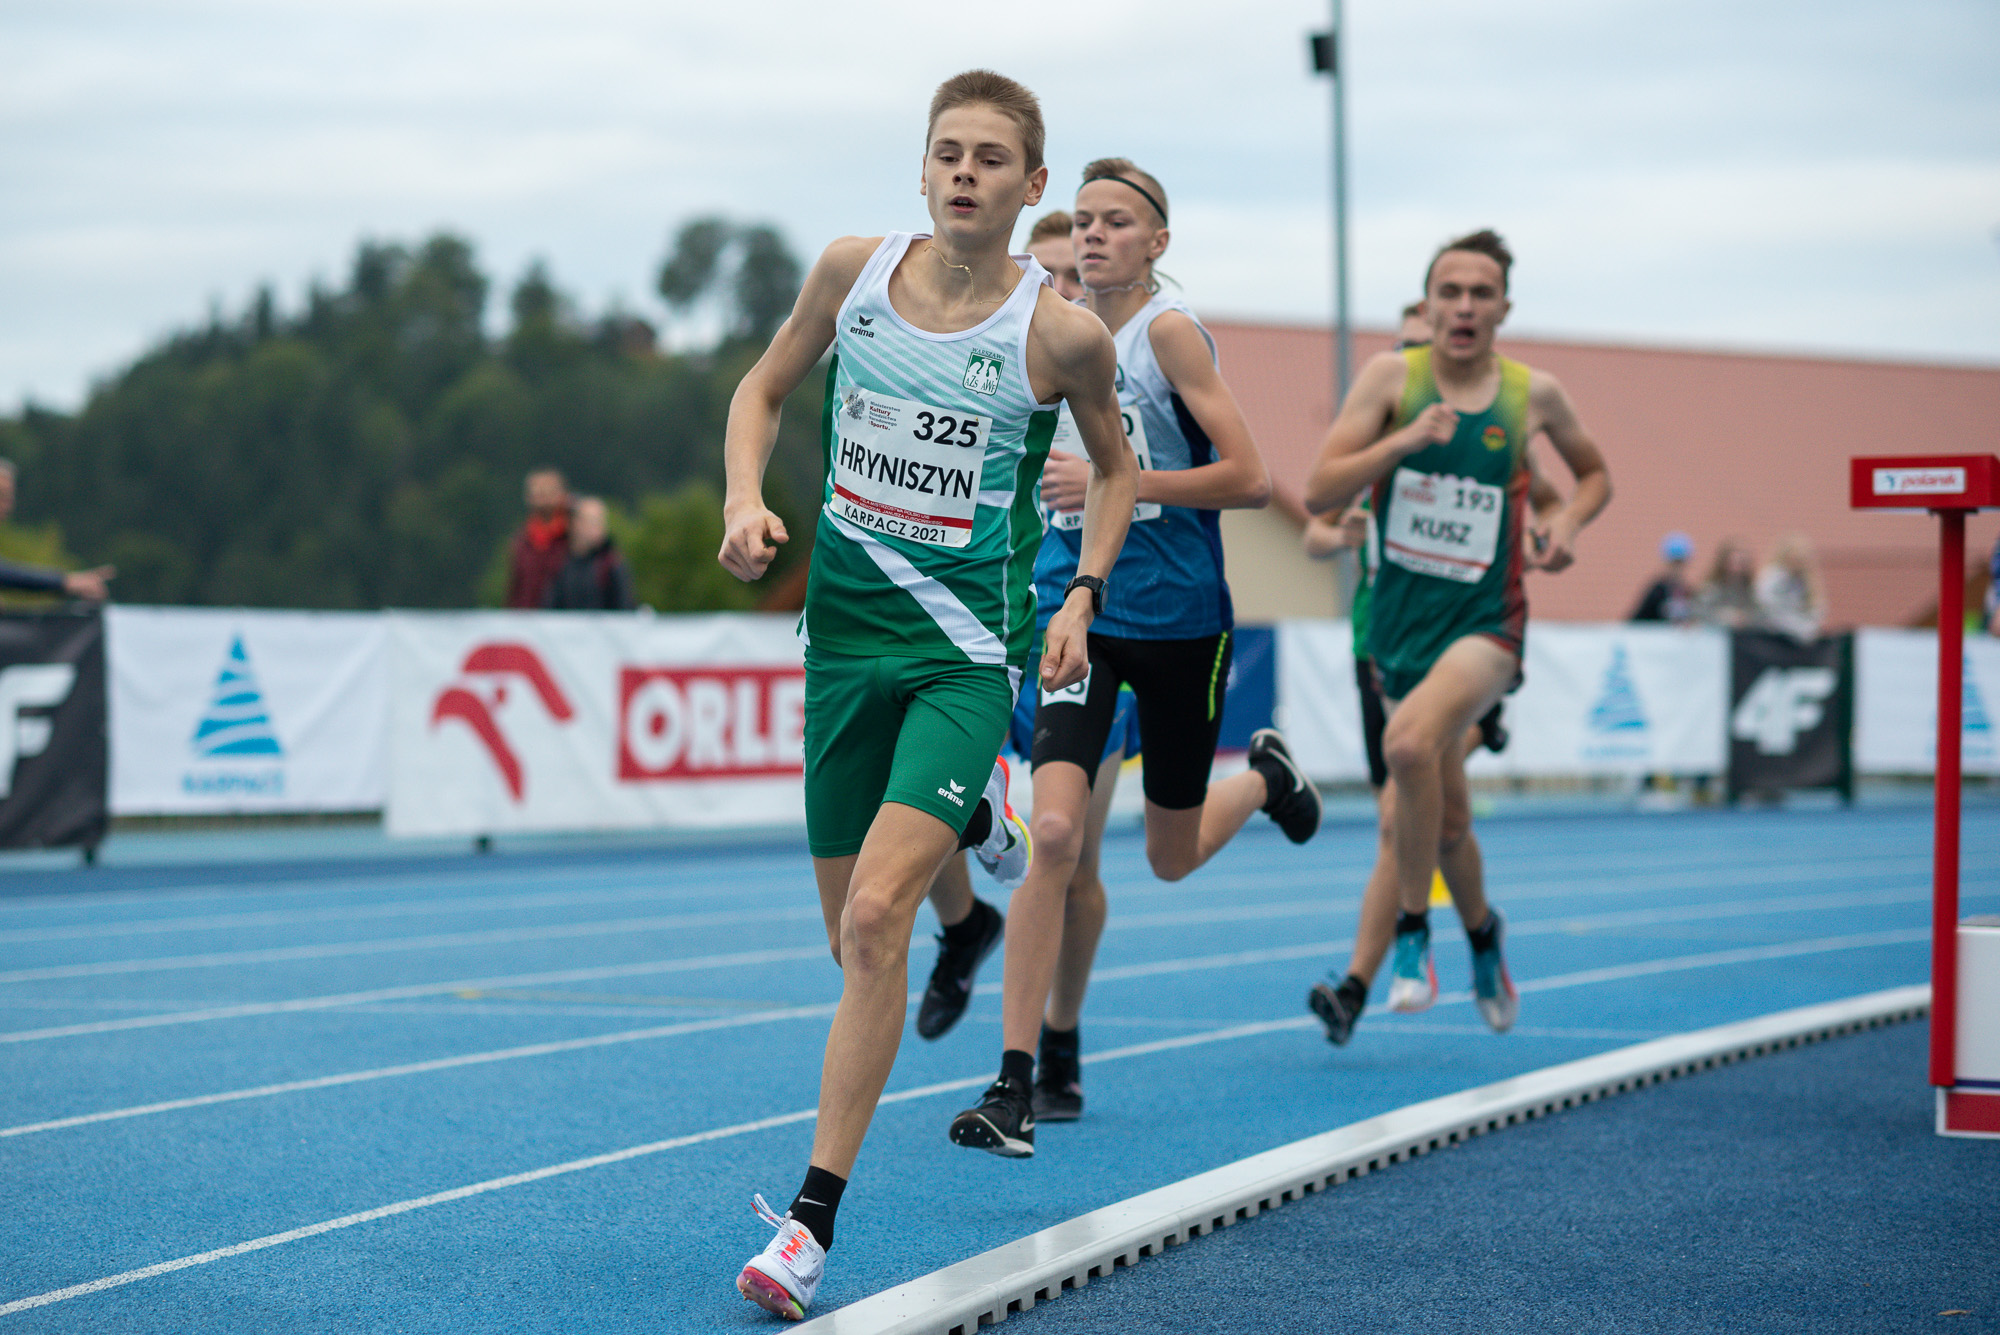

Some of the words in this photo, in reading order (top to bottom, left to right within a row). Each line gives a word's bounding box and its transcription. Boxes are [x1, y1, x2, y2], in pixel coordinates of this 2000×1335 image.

[850, 326, 875, 339] erima
[972, 347, 1005, 361] WARSZAWA
[964, 375, 979, 388] AZS
[981, 379, 997, 393] AWF
[869, 405, 891, 416] Kultury
[870, 400, 901, 412] Ministerstwo
[868, 415, 898, 427] Narodowego
[913, 411, 978, 448] 325
[840, 437, 974, 500] HRYNISZYN
[1455, 489, 1496, 512] 193
[882, 509, 905, 519] JANUSZA
[903, 509, 921, 517] POLSKI
[844, 504, 906, 535] KARPACZ
[910, 525, 946, 543] 2021
[1410, 514, 1472, 546] KUSZ
[1734, 665, 1839, 756] 4F
[0, 663, 78, 799] F
[628, 672, 805, 774] ORLE
[937, 787, 965, 807] erima
